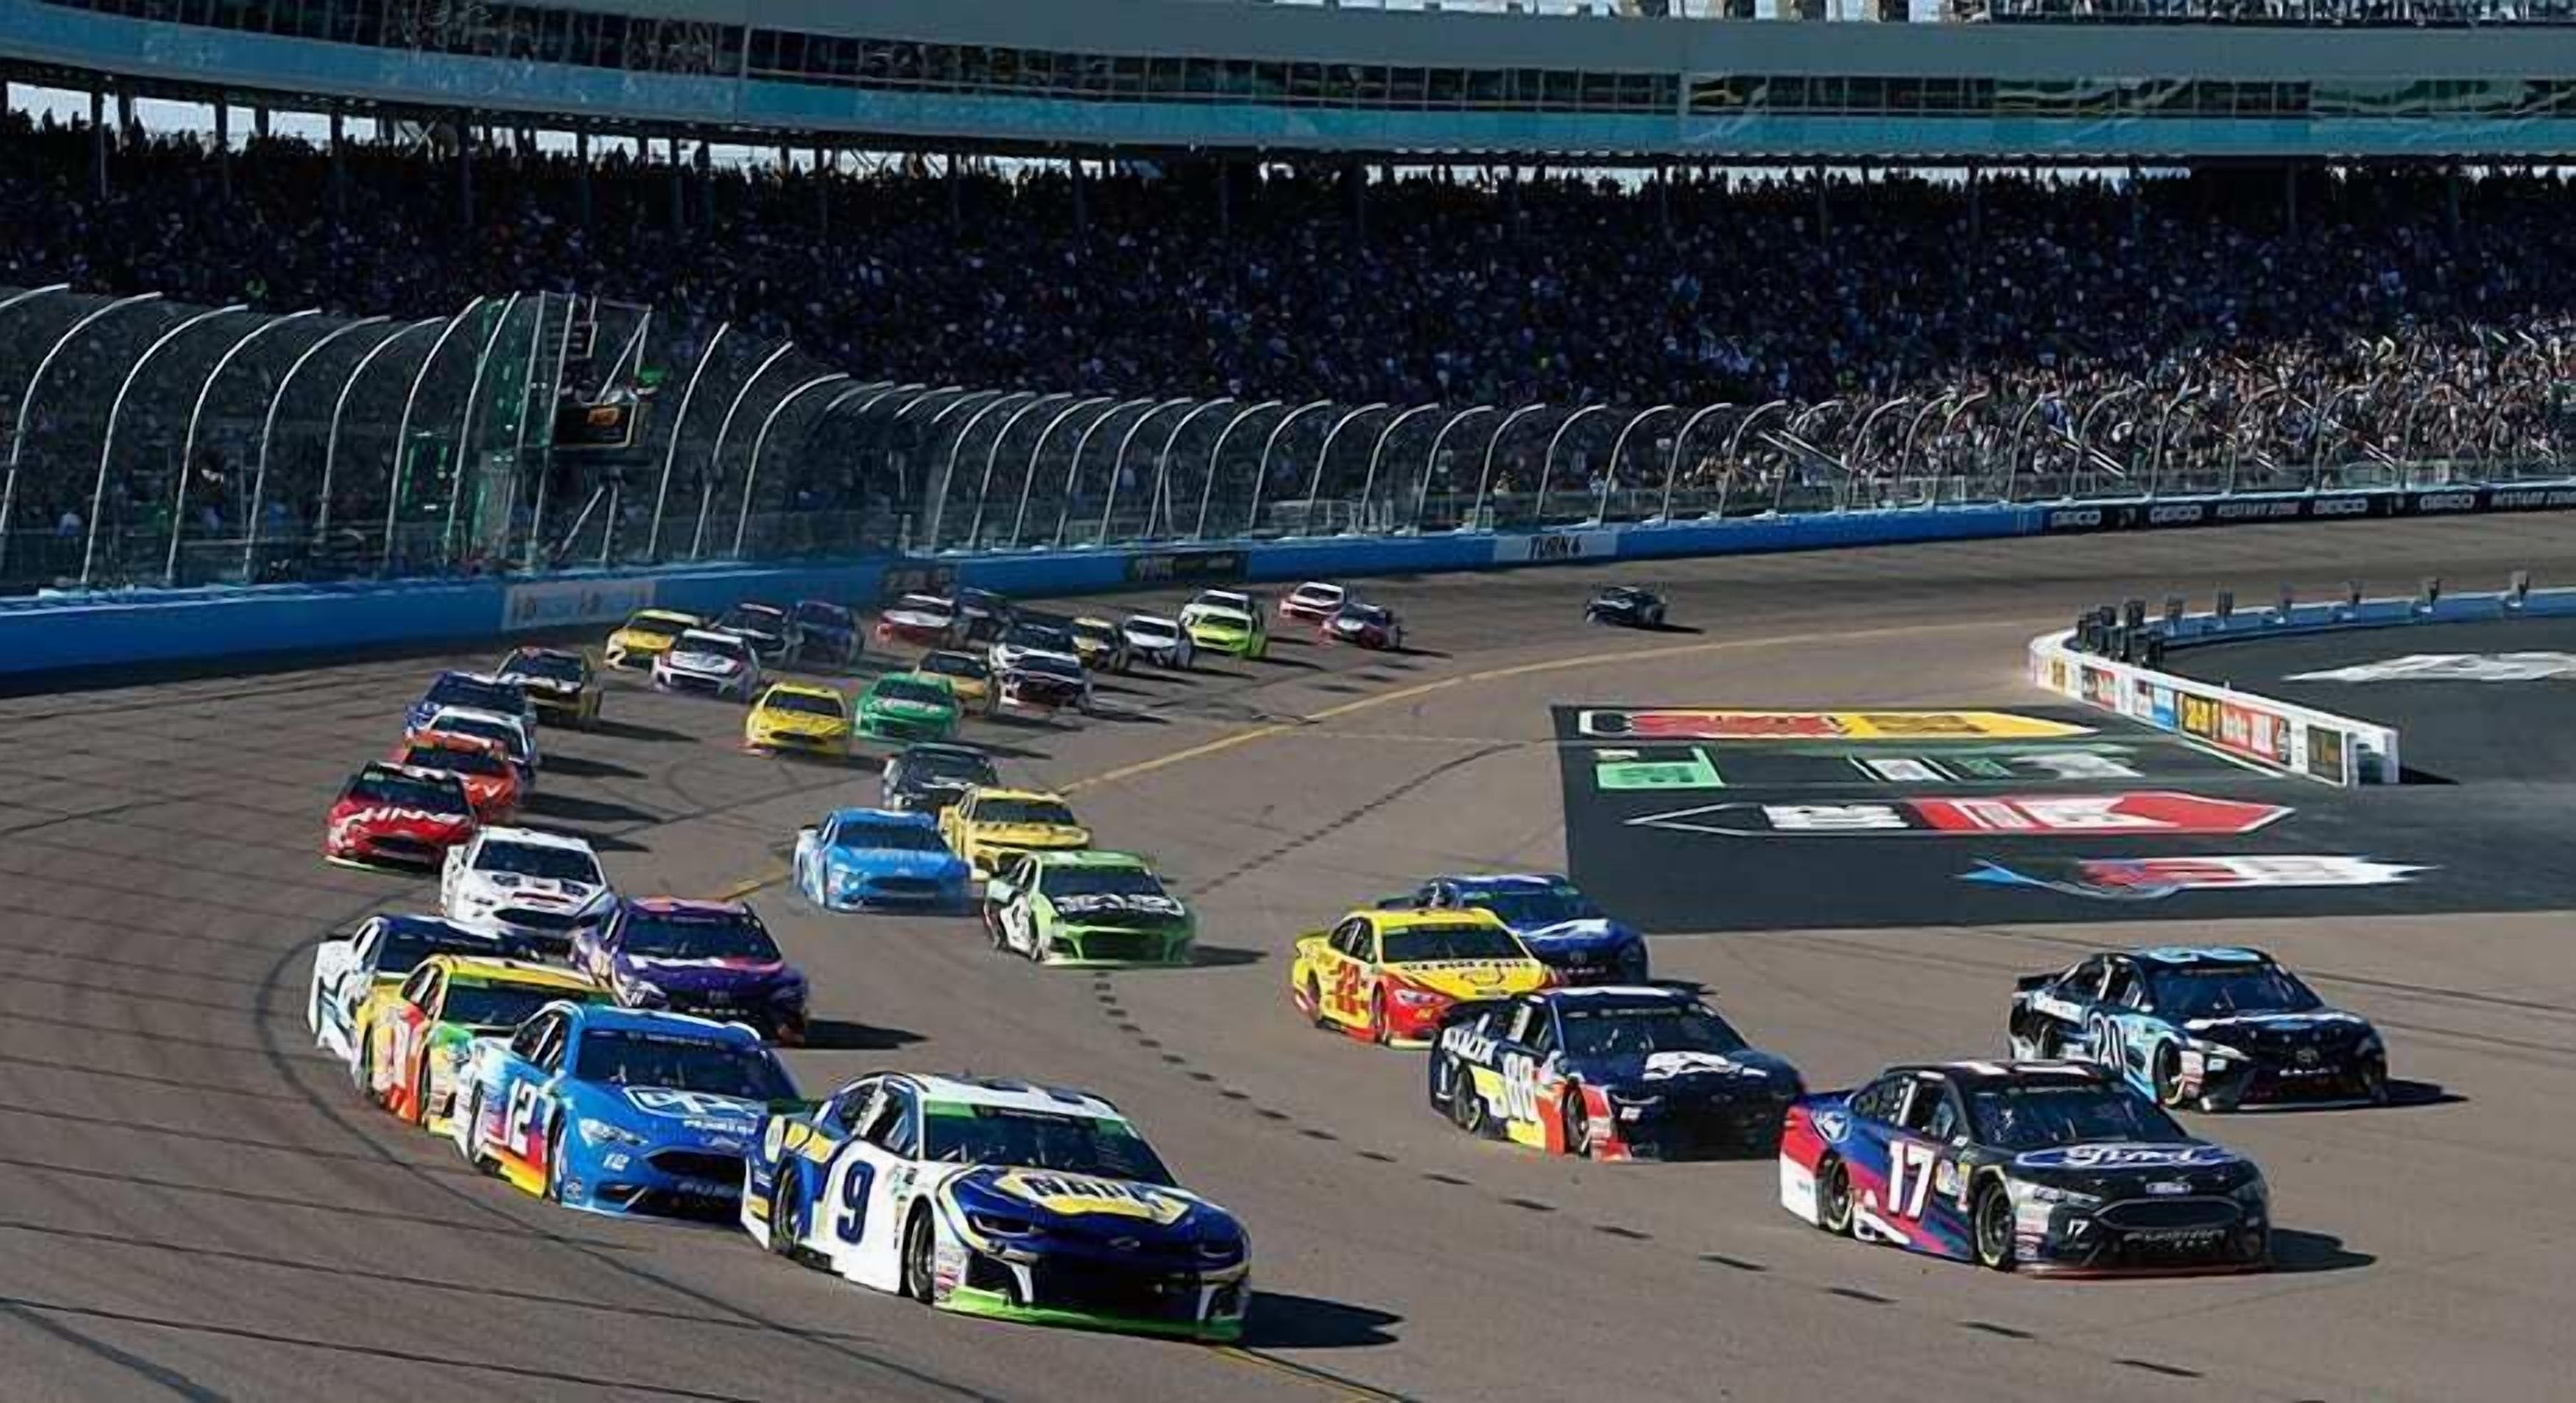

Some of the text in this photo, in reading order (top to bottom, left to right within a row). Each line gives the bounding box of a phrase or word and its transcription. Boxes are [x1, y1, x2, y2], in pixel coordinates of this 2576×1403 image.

[504, 1078, 538, 1158] 12
[603, 1152, 630, 1172] 12
[1887, 1139, 1935, 1219] 17
[836, 1160, 875, 1246] 9
[2066, 1219, 2090, 1237] 17
